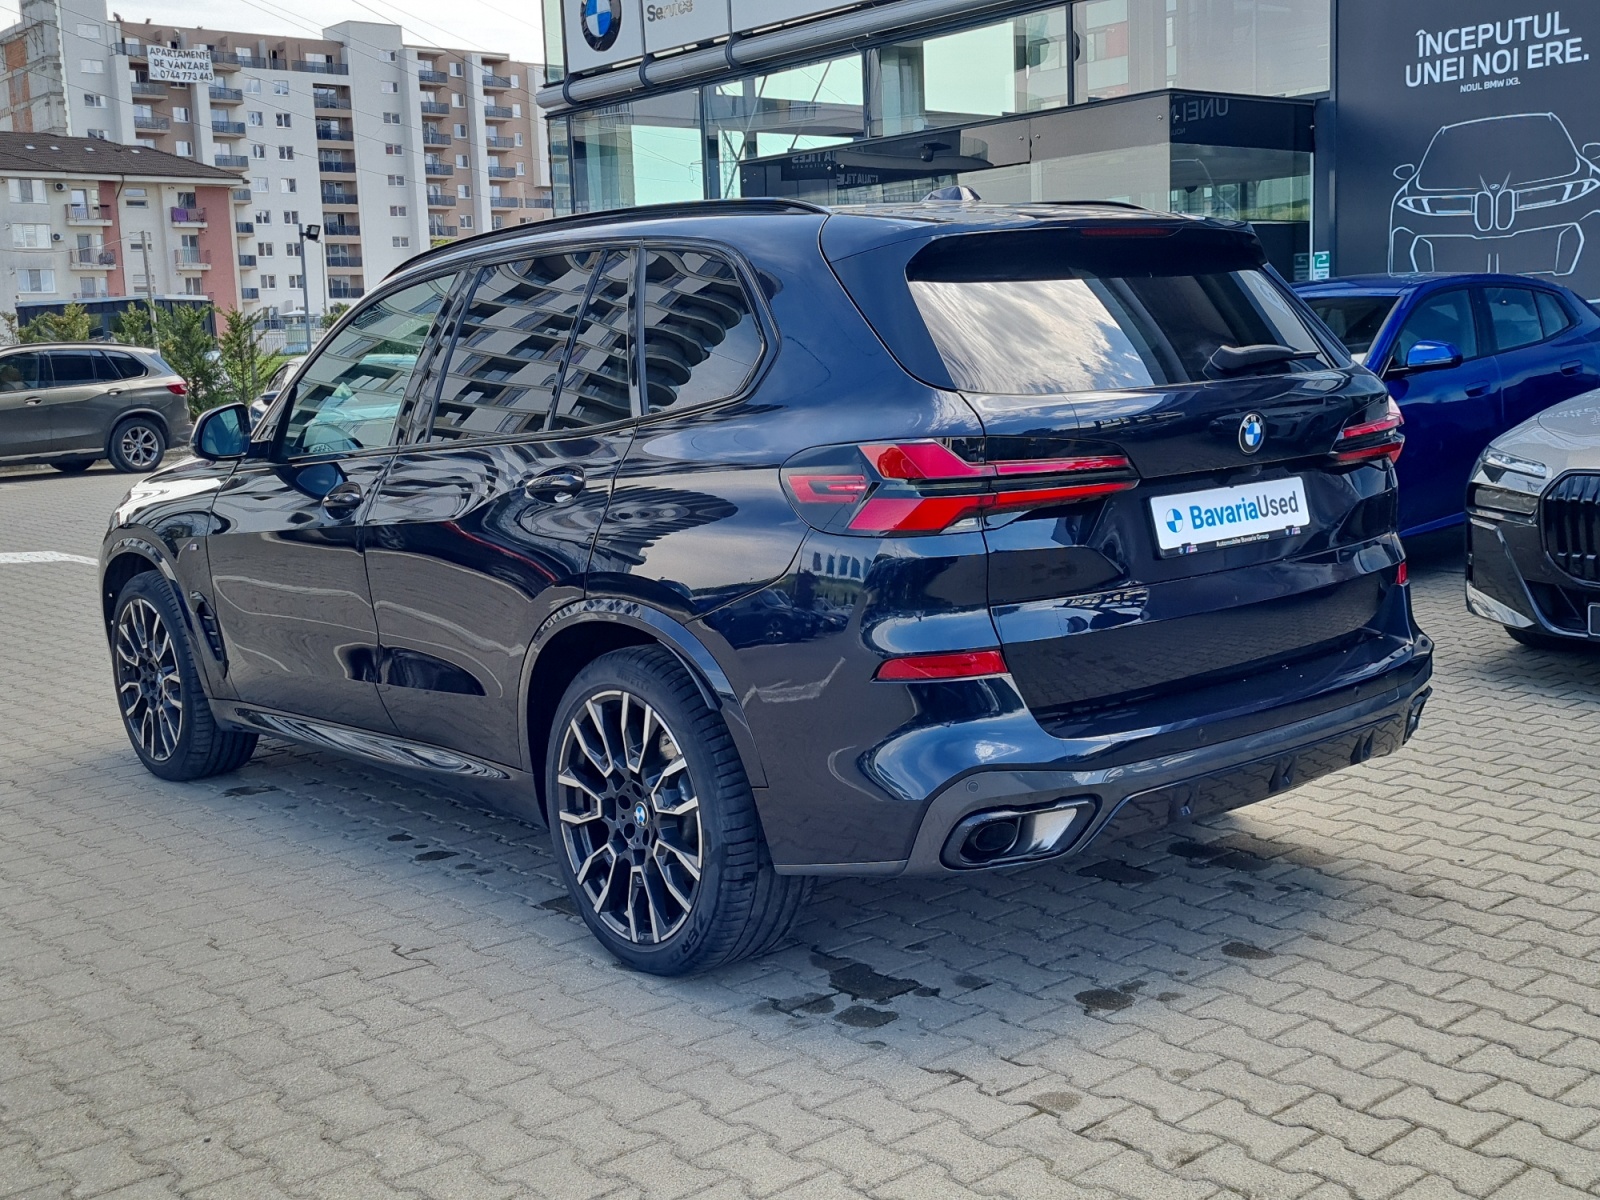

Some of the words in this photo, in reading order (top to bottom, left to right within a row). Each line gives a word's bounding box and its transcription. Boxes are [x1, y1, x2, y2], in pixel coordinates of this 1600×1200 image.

[1415, 11, 1570, 58] ÎNCEPUTUL
[149, 47, 210, 59] APARTAMENTE
[153, 58, 164, 68] DE
[1405, 56, 1465, 88] UNEI
[1472, 47, 1519, 77] NOI
[1527, 37, 1590, 70] ERE.
[160, 70, 180, 80] 0744
[182, 72, 198, 81] 773
[199, 72, 214, 81] 443
[1460, 82, 1483, 93] NOUL
[1483, 79, 1505, 90] BMW
[1188, 491, 1300, 530] BavariaUsed
